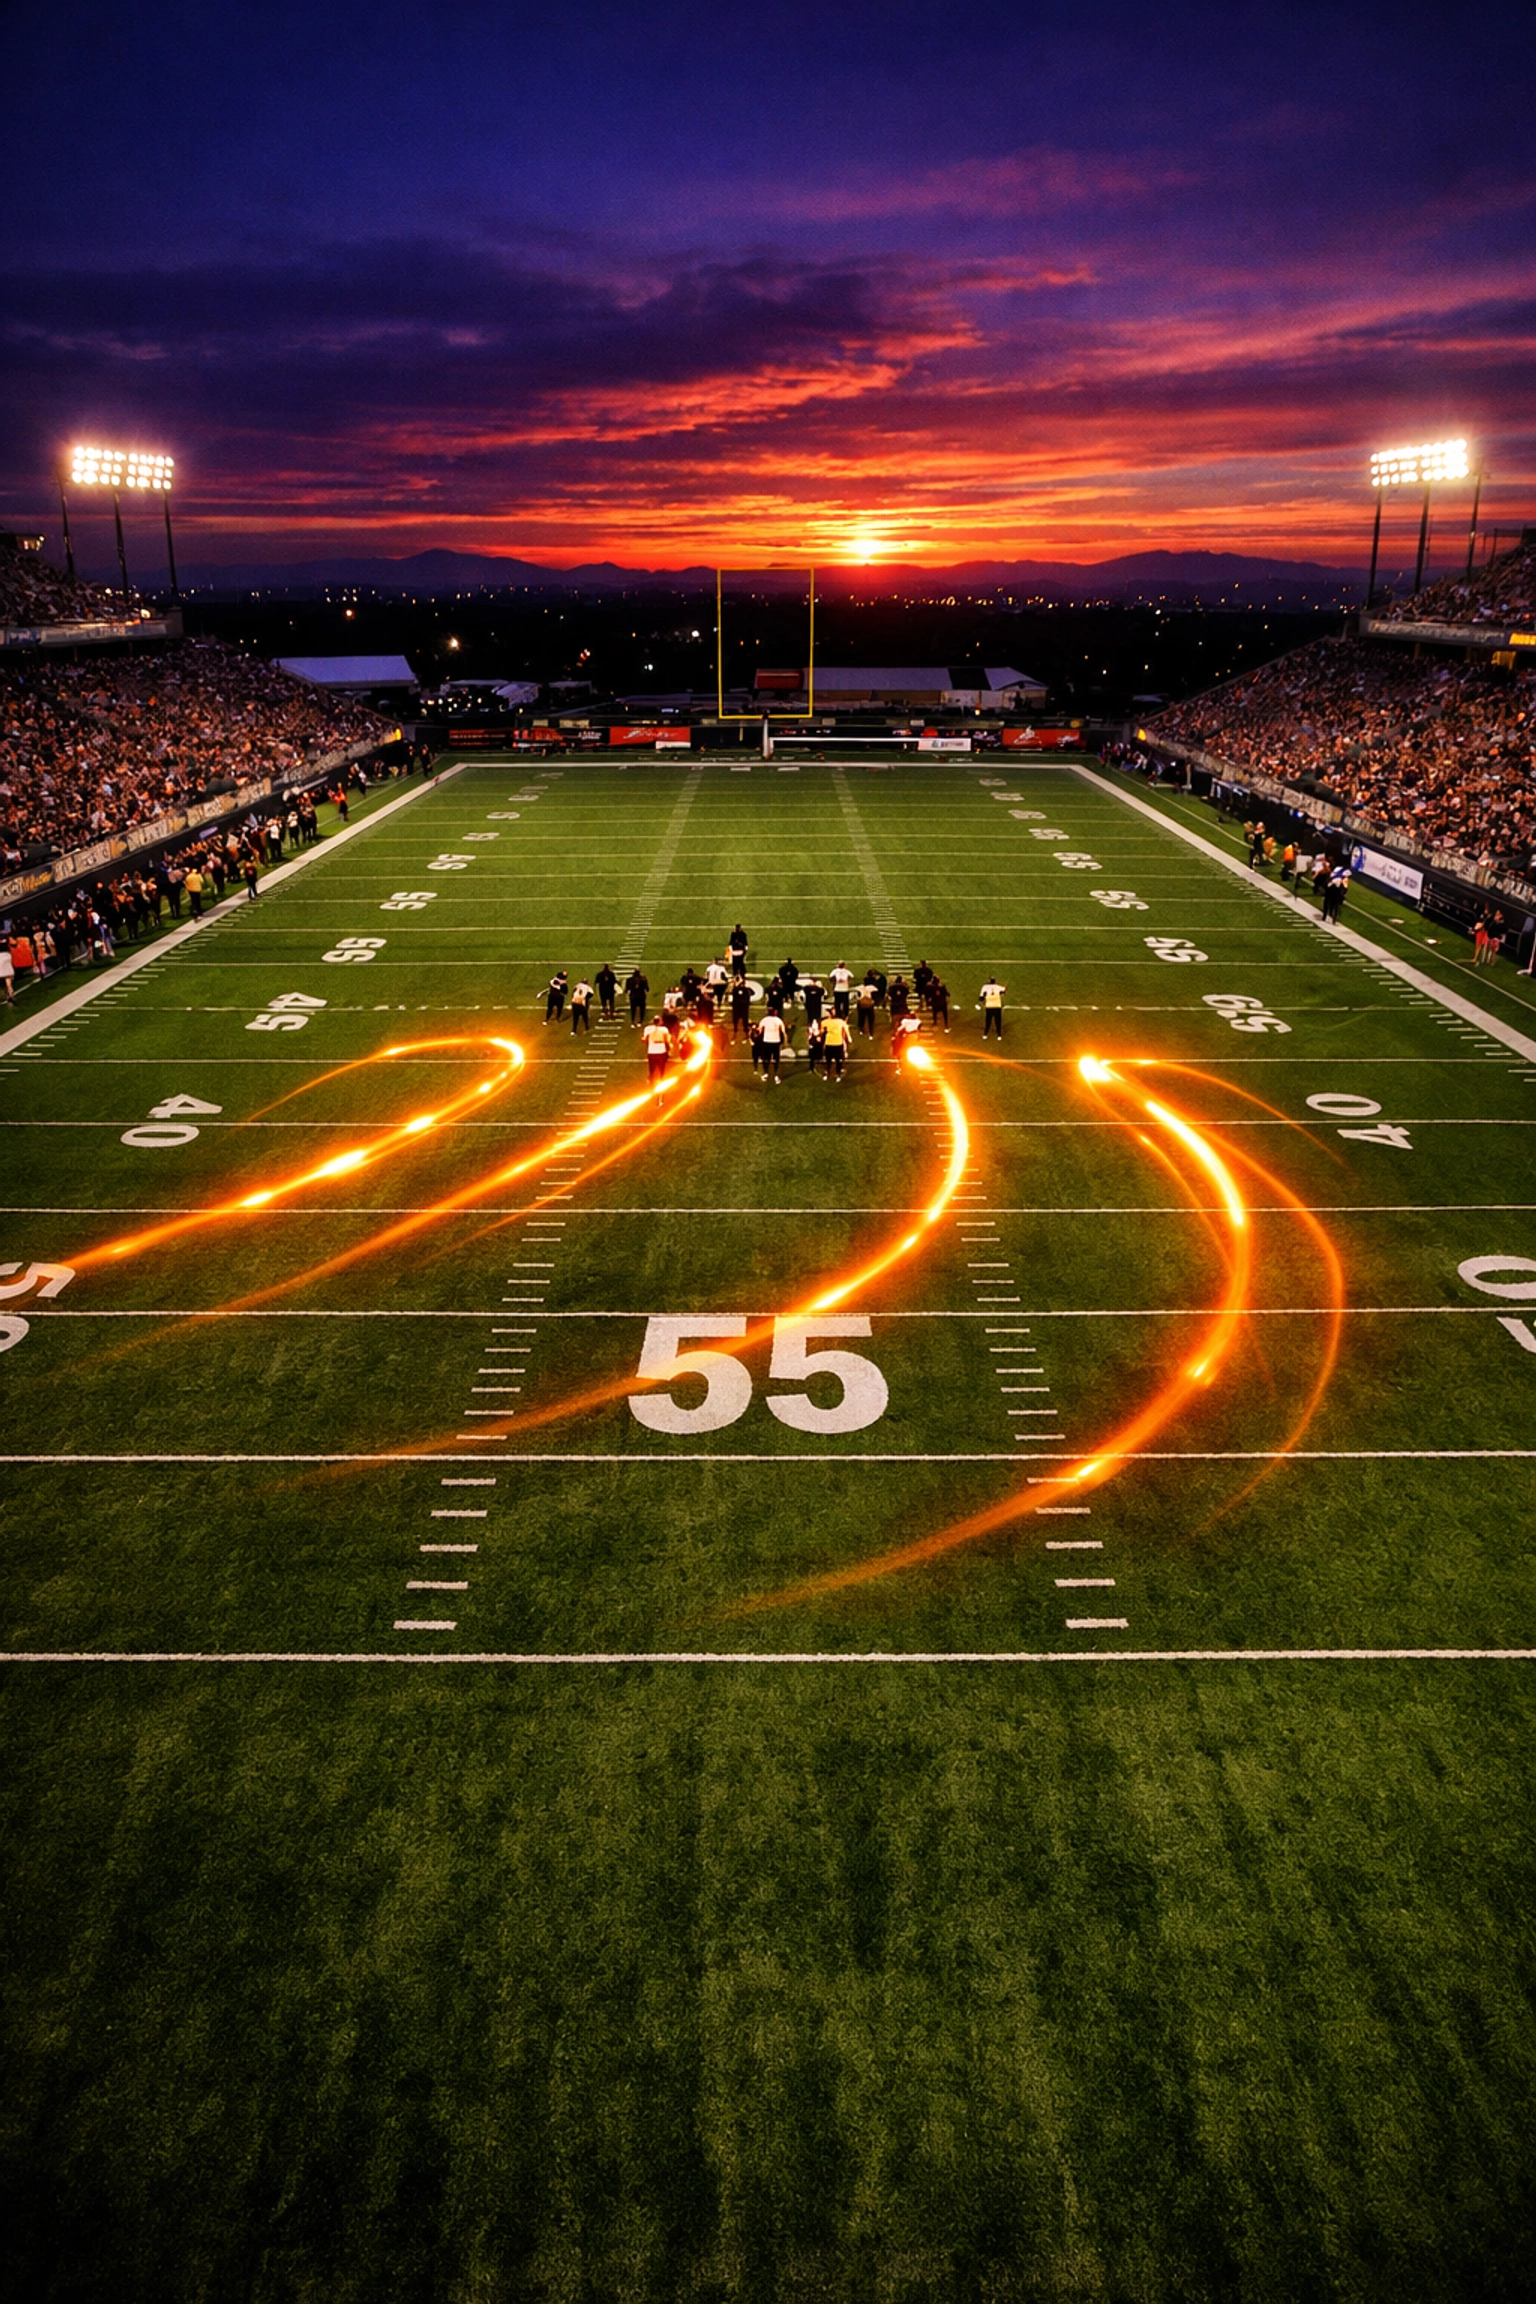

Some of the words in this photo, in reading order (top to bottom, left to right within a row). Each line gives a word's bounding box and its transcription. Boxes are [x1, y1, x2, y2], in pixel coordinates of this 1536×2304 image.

[120, 1093, 223, 1148] 40
[1305, 1093, 1414, 1150] 40
[627, 1315, 889, 1434] 55
